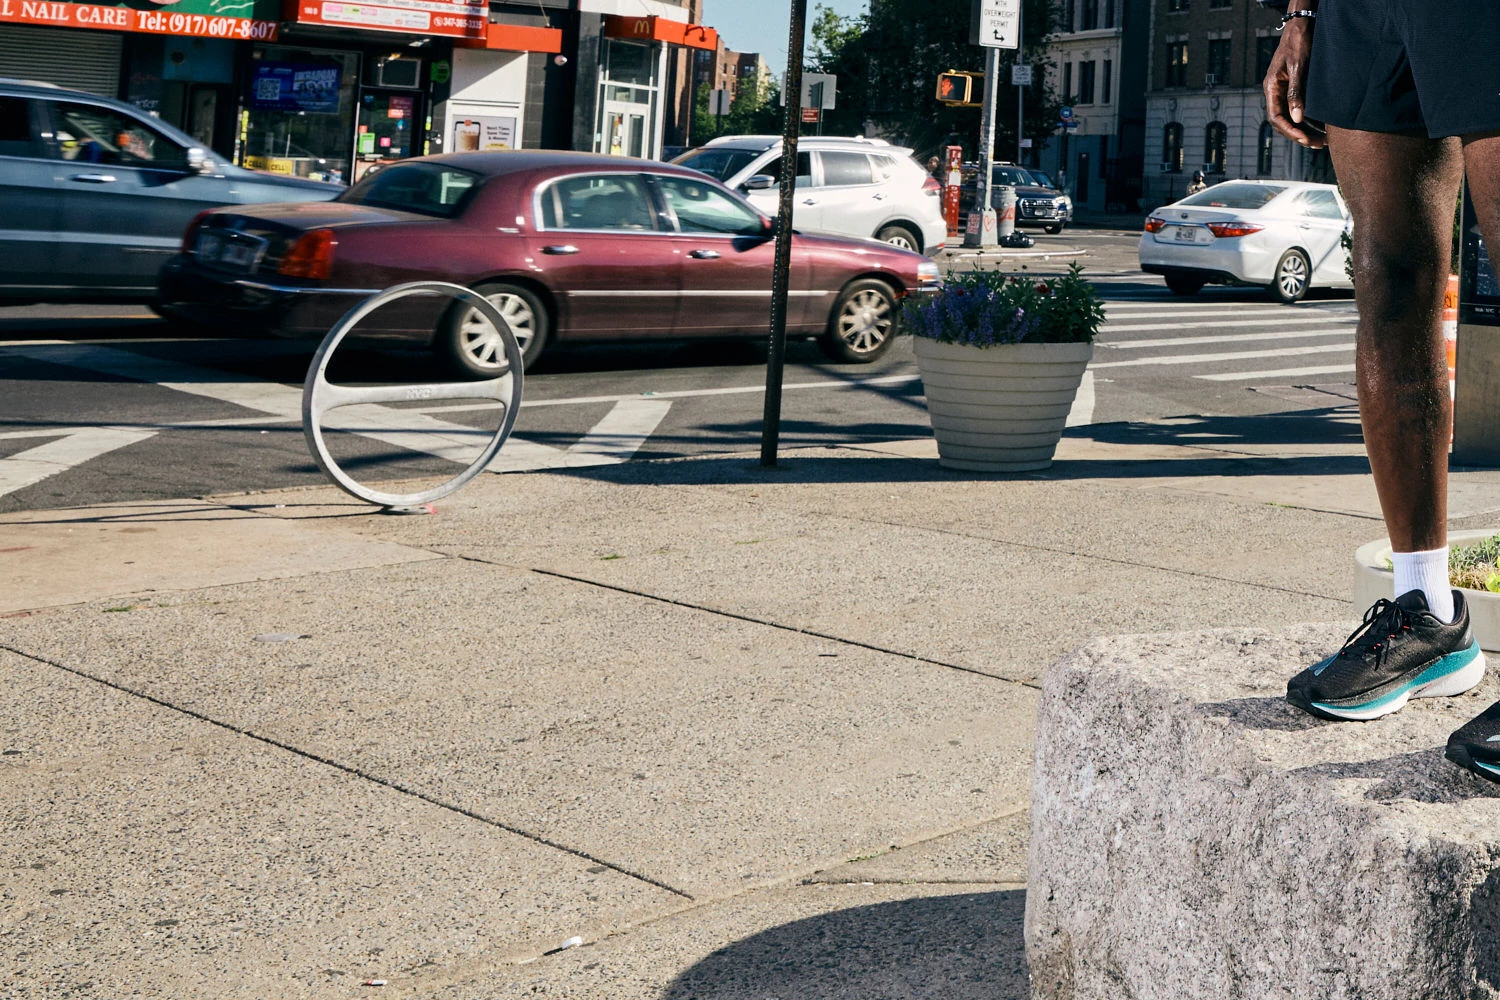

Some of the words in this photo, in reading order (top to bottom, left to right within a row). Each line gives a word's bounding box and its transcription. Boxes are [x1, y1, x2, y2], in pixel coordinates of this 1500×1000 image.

[21, 1, 70, 21] NAIL
[76, 6, 128, 26] CARE
[137, 10, 167, 32] Tel:
[984, 8, 1016, 18] OVERWEIGHT
[990, 20, 1009, 29] PERMIT
